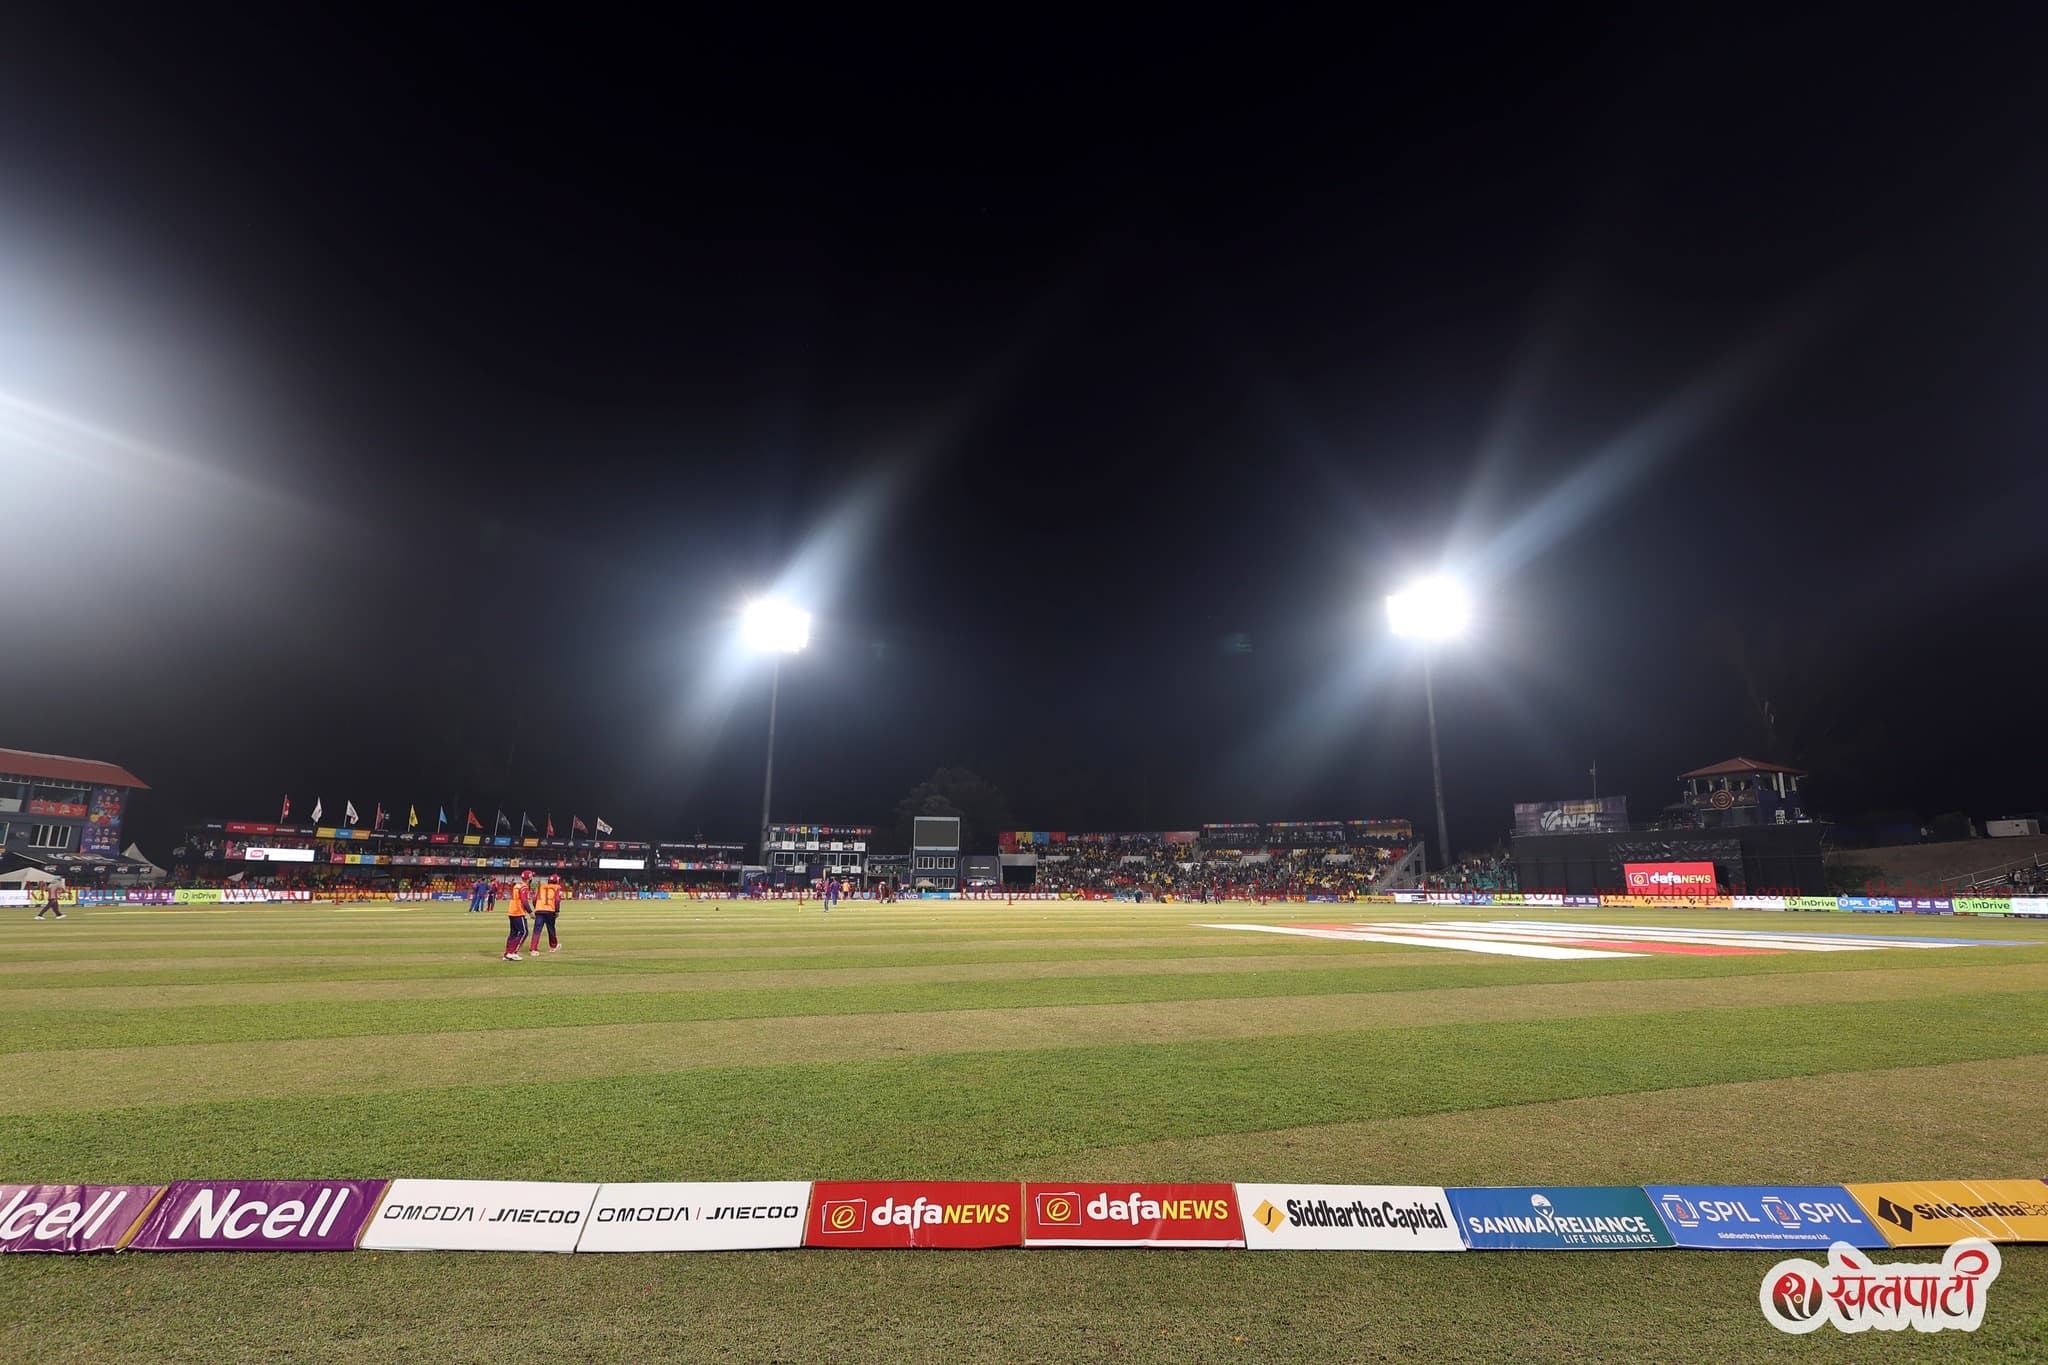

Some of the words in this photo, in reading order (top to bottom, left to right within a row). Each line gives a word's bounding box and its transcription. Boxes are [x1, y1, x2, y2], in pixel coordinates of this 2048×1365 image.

[1649, 872, 1711, 886] dafaNEWS
[1801, 899, 1836, 907] inDrive
[1972, 901, 2010, 910] inDrive
[168, 1188, 350, 1240] Ncell
[384, 1204, 474, 1222] OMODA
[488, 1208, 580, 1224] JAECOO
[597, 1207, 689, 1222] OMODA
[705, 1205, 799, 1220] JAECOO
[871, 1196, 1010, 1230] dafaNEWS
[1086, 1192, 1229, 1226] dafaNEWS
[1699, 1201, 1760, 1223] SPIL
[1798, 1201, 1863, 1225] SPIL
[1468, 1216, 1550, 1234] SANIMA
[1555, 1216, 1651, 1233] RELIANCE
[1563, 1234, 1587, 1244] LIFE
[1590, 1234, 1658, 1244] INSURANCE
